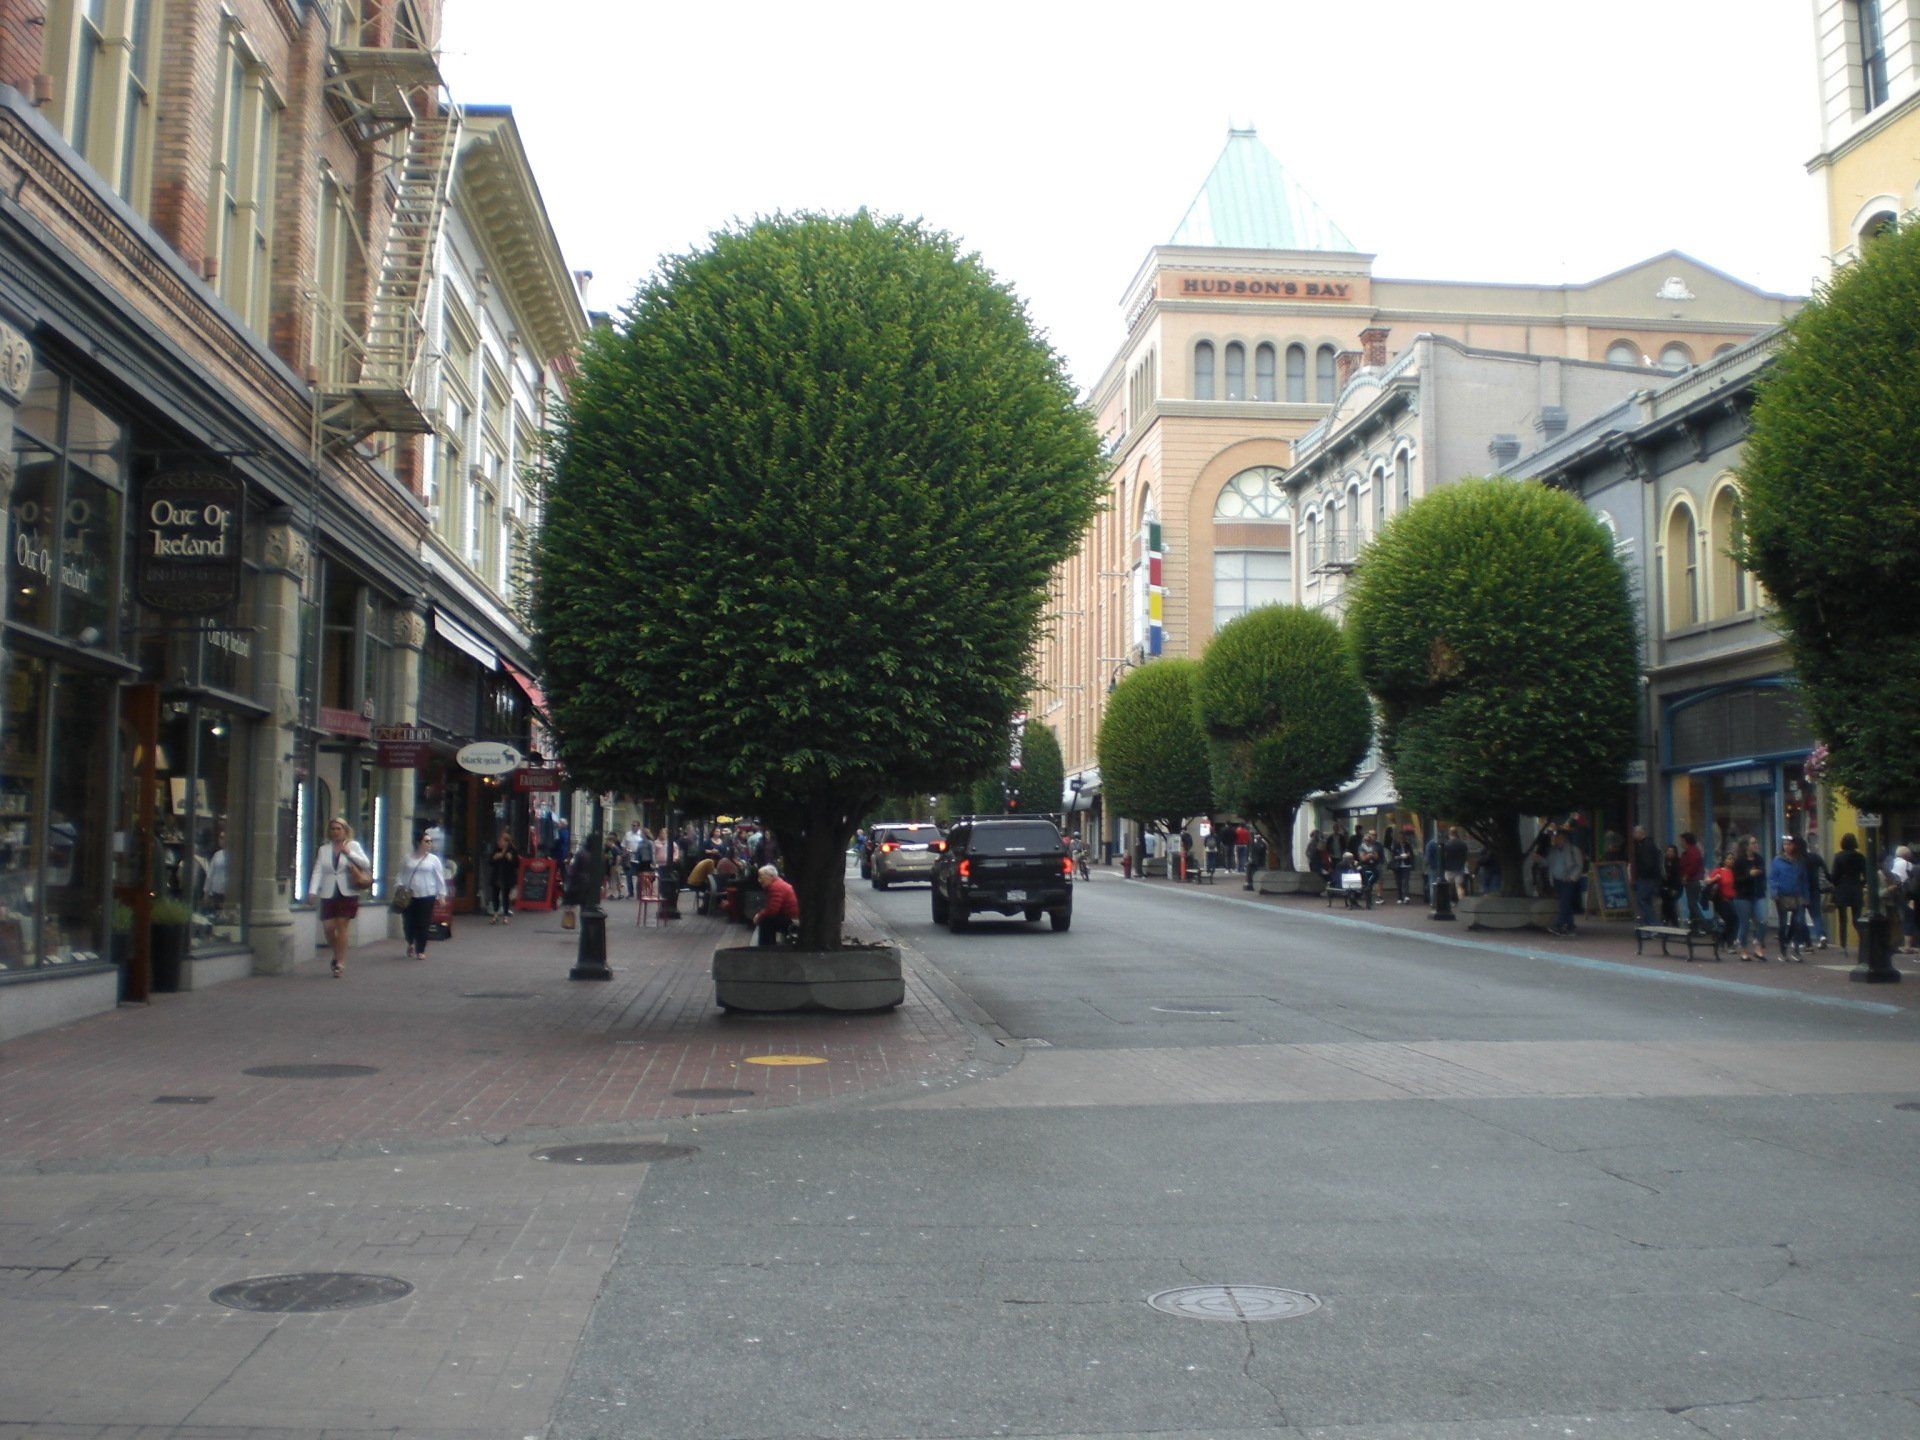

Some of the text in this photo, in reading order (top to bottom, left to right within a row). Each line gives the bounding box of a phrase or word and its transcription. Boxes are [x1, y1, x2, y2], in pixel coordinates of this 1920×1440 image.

[1183, 278, 1350, 297] HUDSON'S BAY
[151, 500, 231, 534] Out Of
[147, 529, 224, 556] Ireland
[17, 533, 39, 571] Out
[61, 562, 88, 594] reland
